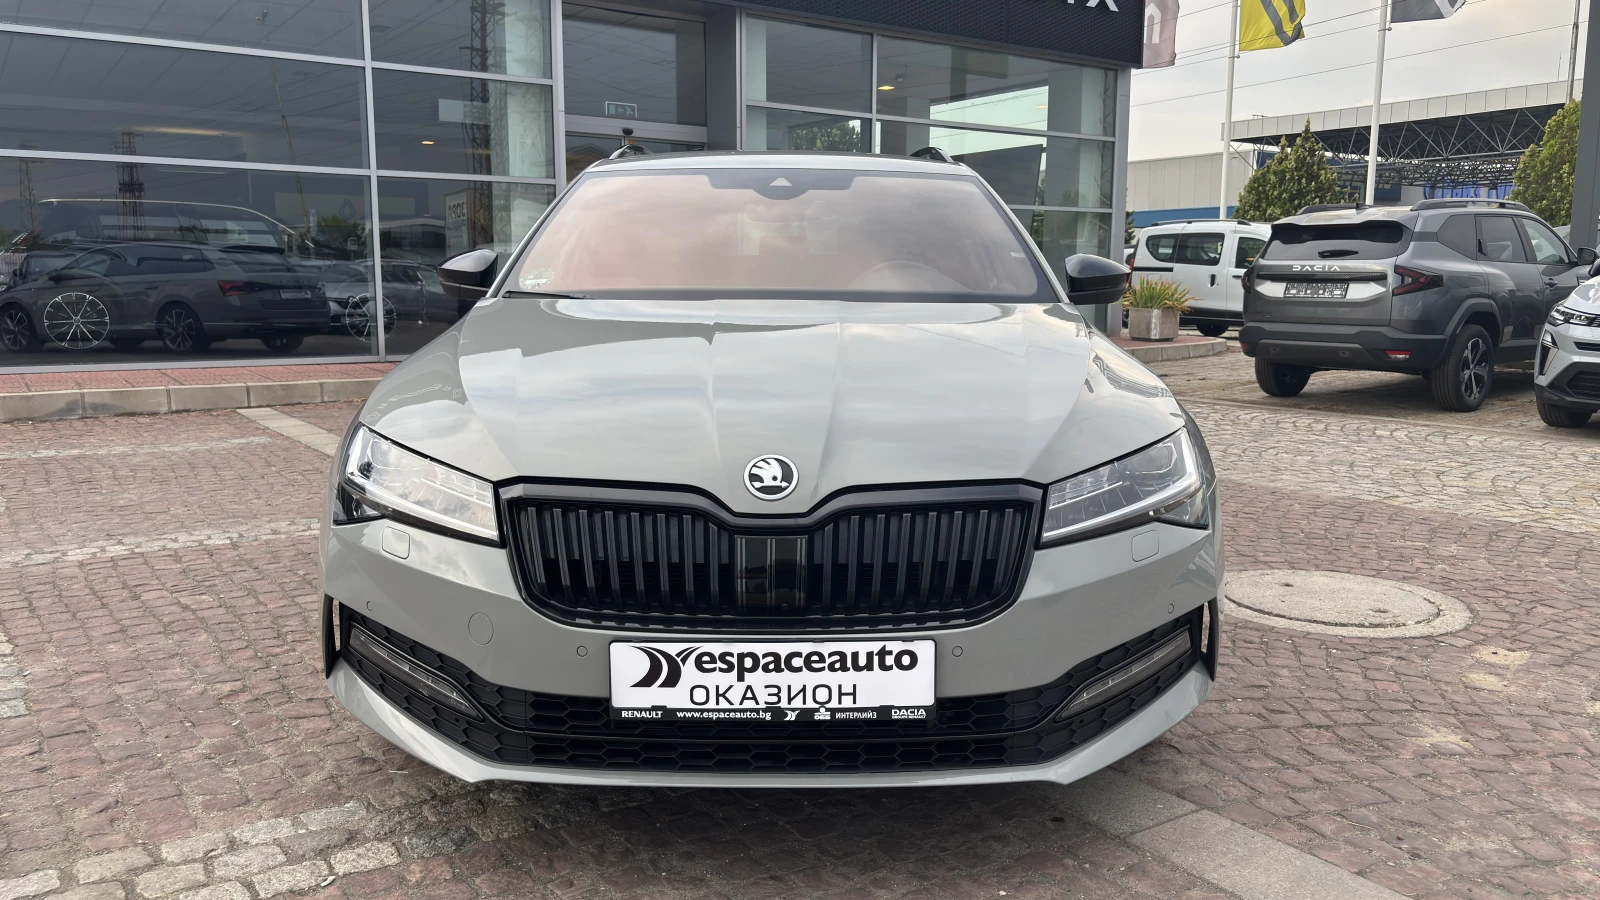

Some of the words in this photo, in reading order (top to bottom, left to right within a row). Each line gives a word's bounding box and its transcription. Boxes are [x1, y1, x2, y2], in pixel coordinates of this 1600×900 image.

[694, 644, 919, 682] espaceauto
[689, 683, 857, 706] ОКАЗИОН
[621, 710, 663, 718] RENAULT
[676, 710, 772, 720] www.espaceauto.bg
[835, 710, 877, 719] ИНТЕРЛИЙЗ
